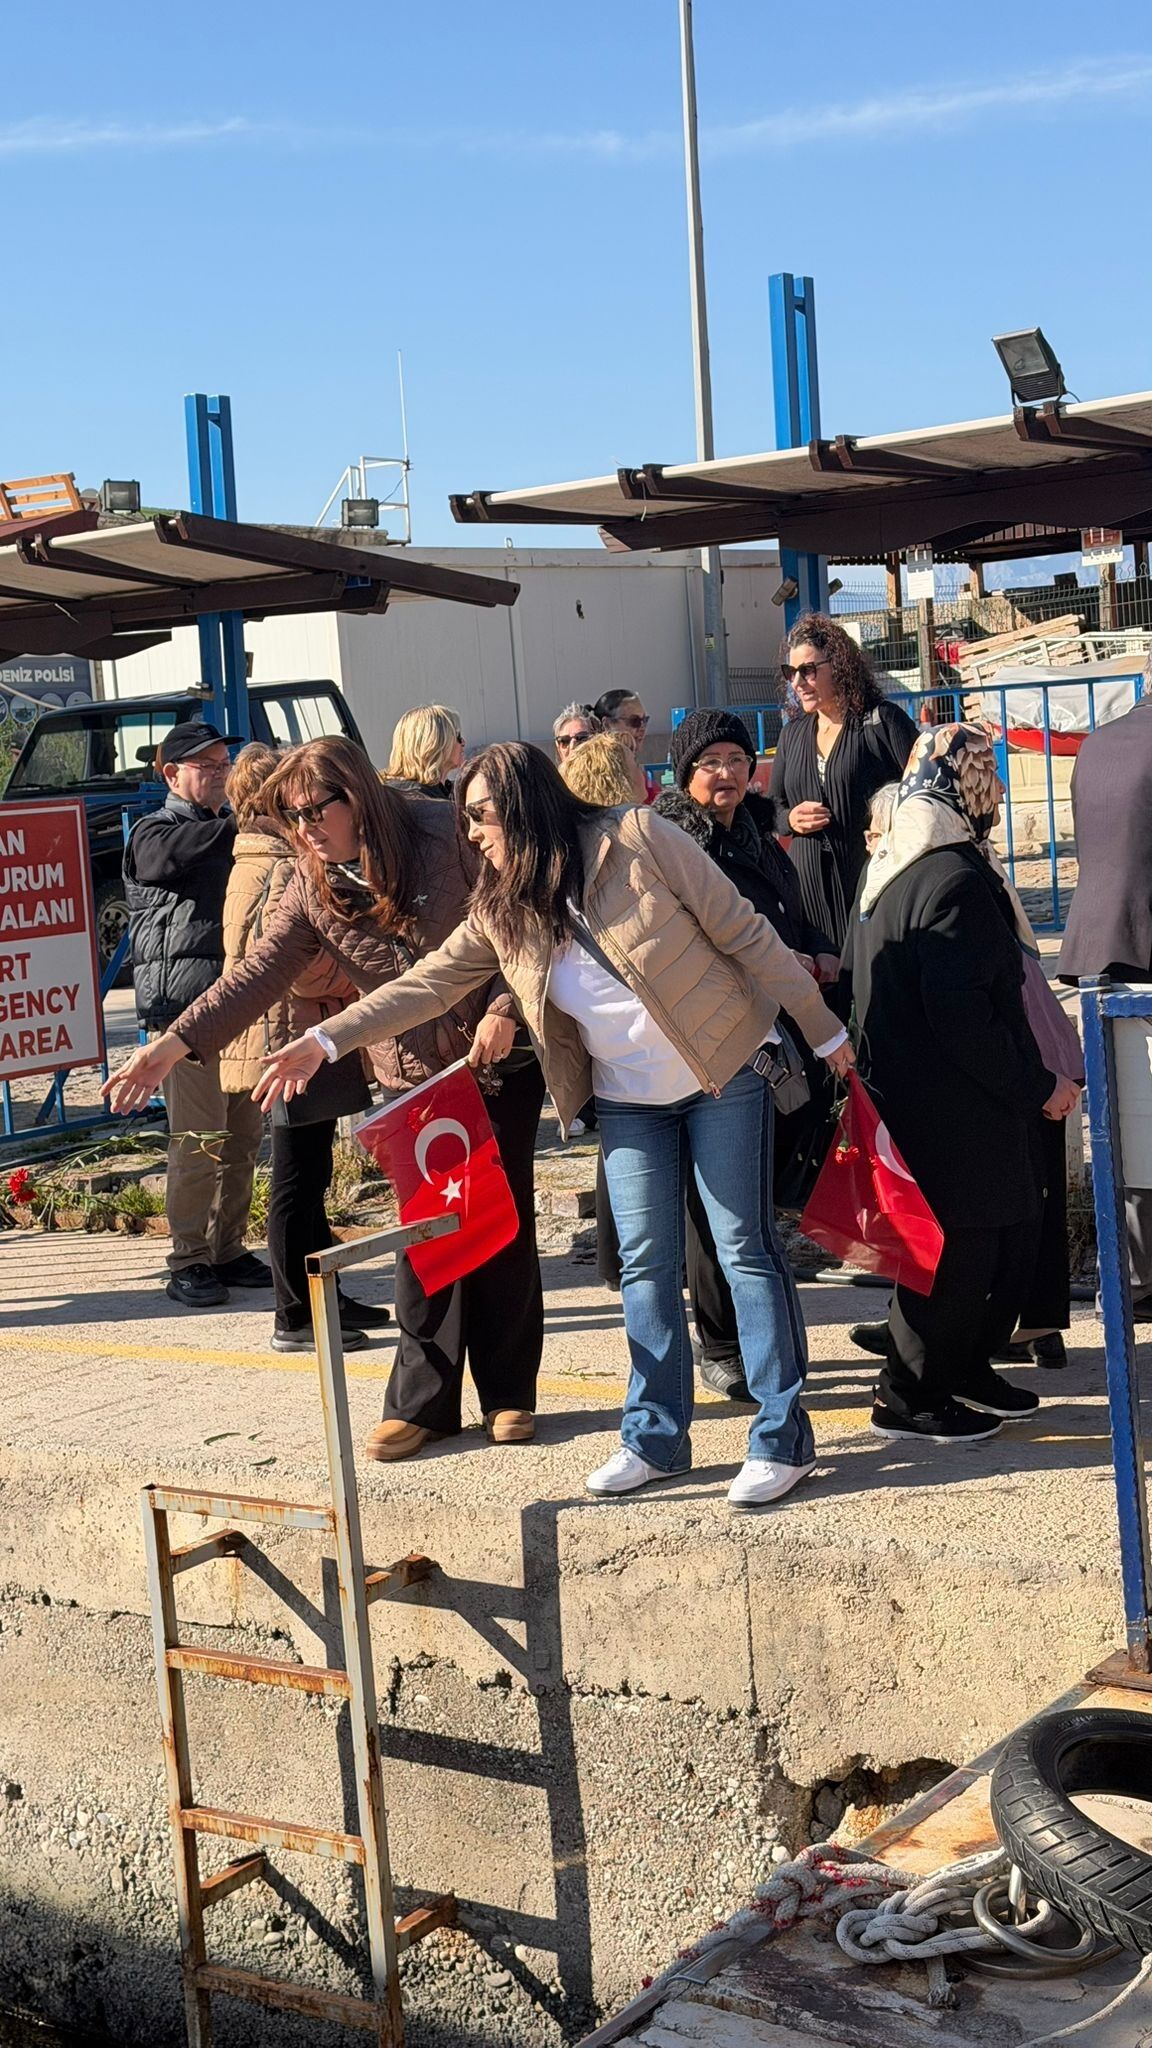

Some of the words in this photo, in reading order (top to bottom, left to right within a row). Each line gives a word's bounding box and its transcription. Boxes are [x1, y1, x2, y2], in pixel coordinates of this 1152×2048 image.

[0, 666, 33, 682] ENİZ
[35, 666, 75, 682] POLİSİ
[0, 897, 75, 931] ALANI
[0, 1023, 73, 1062] AREA
